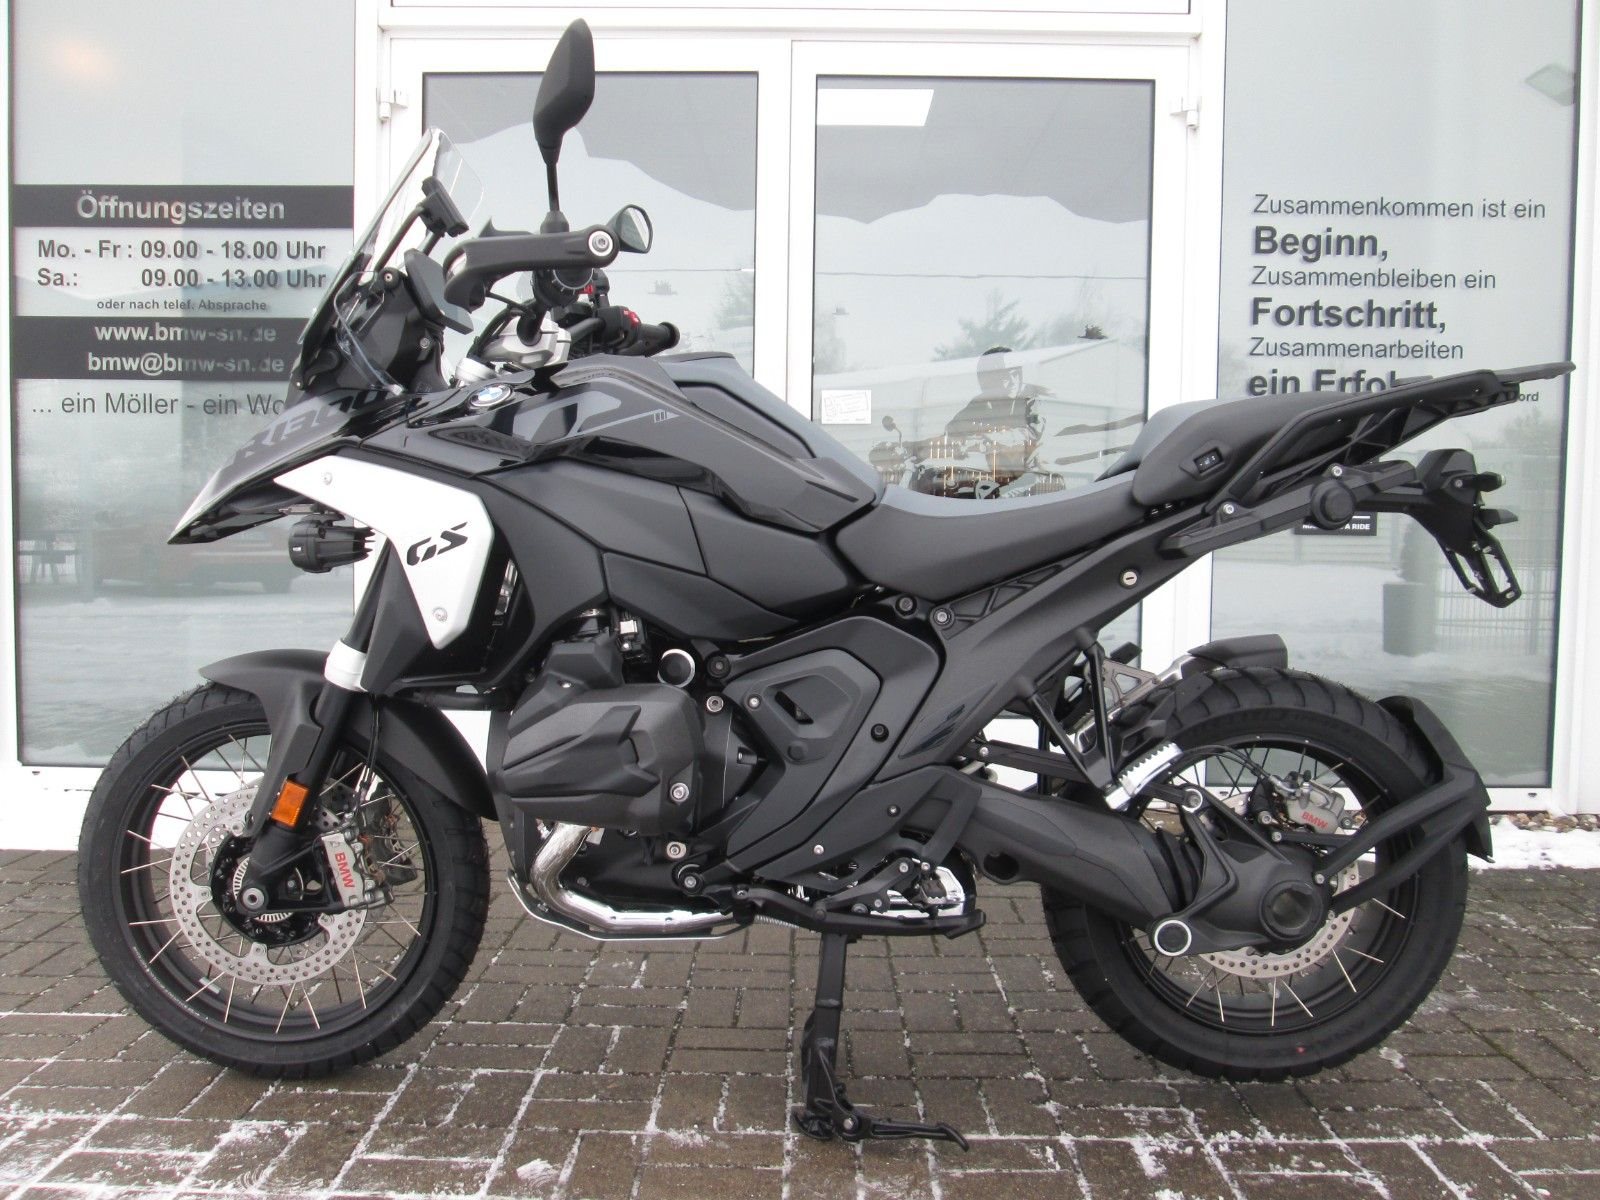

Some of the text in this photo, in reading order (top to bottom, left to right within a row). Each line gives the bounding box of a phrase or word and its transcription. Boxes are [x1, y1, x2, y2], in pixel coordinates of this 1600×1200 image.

[77, 190, 285, 225] Öffnungszeiten
[1253, 194, 1546, 218] Zusammenkommen ist ein
[38, 240, 77, 258] Mo.
[141, 241, 198, 258] 09.00
[222, 241, 278, 259] 18.00
[286, 242, 326, 259] Uhr
[1254, 226, 1388, 262] Beginn,
[37, 268, 78, 287] Sa.:
[141, 269, 199, 288] 09.00
[222, 269, 278, 288] 13.00
[286, 270, 326, 288] Uhr
[1251, 266, 1496, 289] Zusammenbleiben ein
[97, 299, 267, 312] oder nach telef. Absprache
[1251, 297, 1446, 333] Fortschritt,
[95, 323, 276, 342] www.bmw-sn.de
[1249, 337, 1463, 359] Zusammenarbeiten
[88, 353, 284, 375] bmw@bmw-sn.de
[1248, 369, 1396, 396] ein Erfol
[61, 393, 95, 413] ein
[106, 392, 178, 414] Möller
[204, 394, 238, 414] ein
[1519, 392, 1539, 401] ord
[407, 521, 468, 566] GS
[1302, 811, 1328, 829] BMW
[335, 852, 355, 888] BMW
